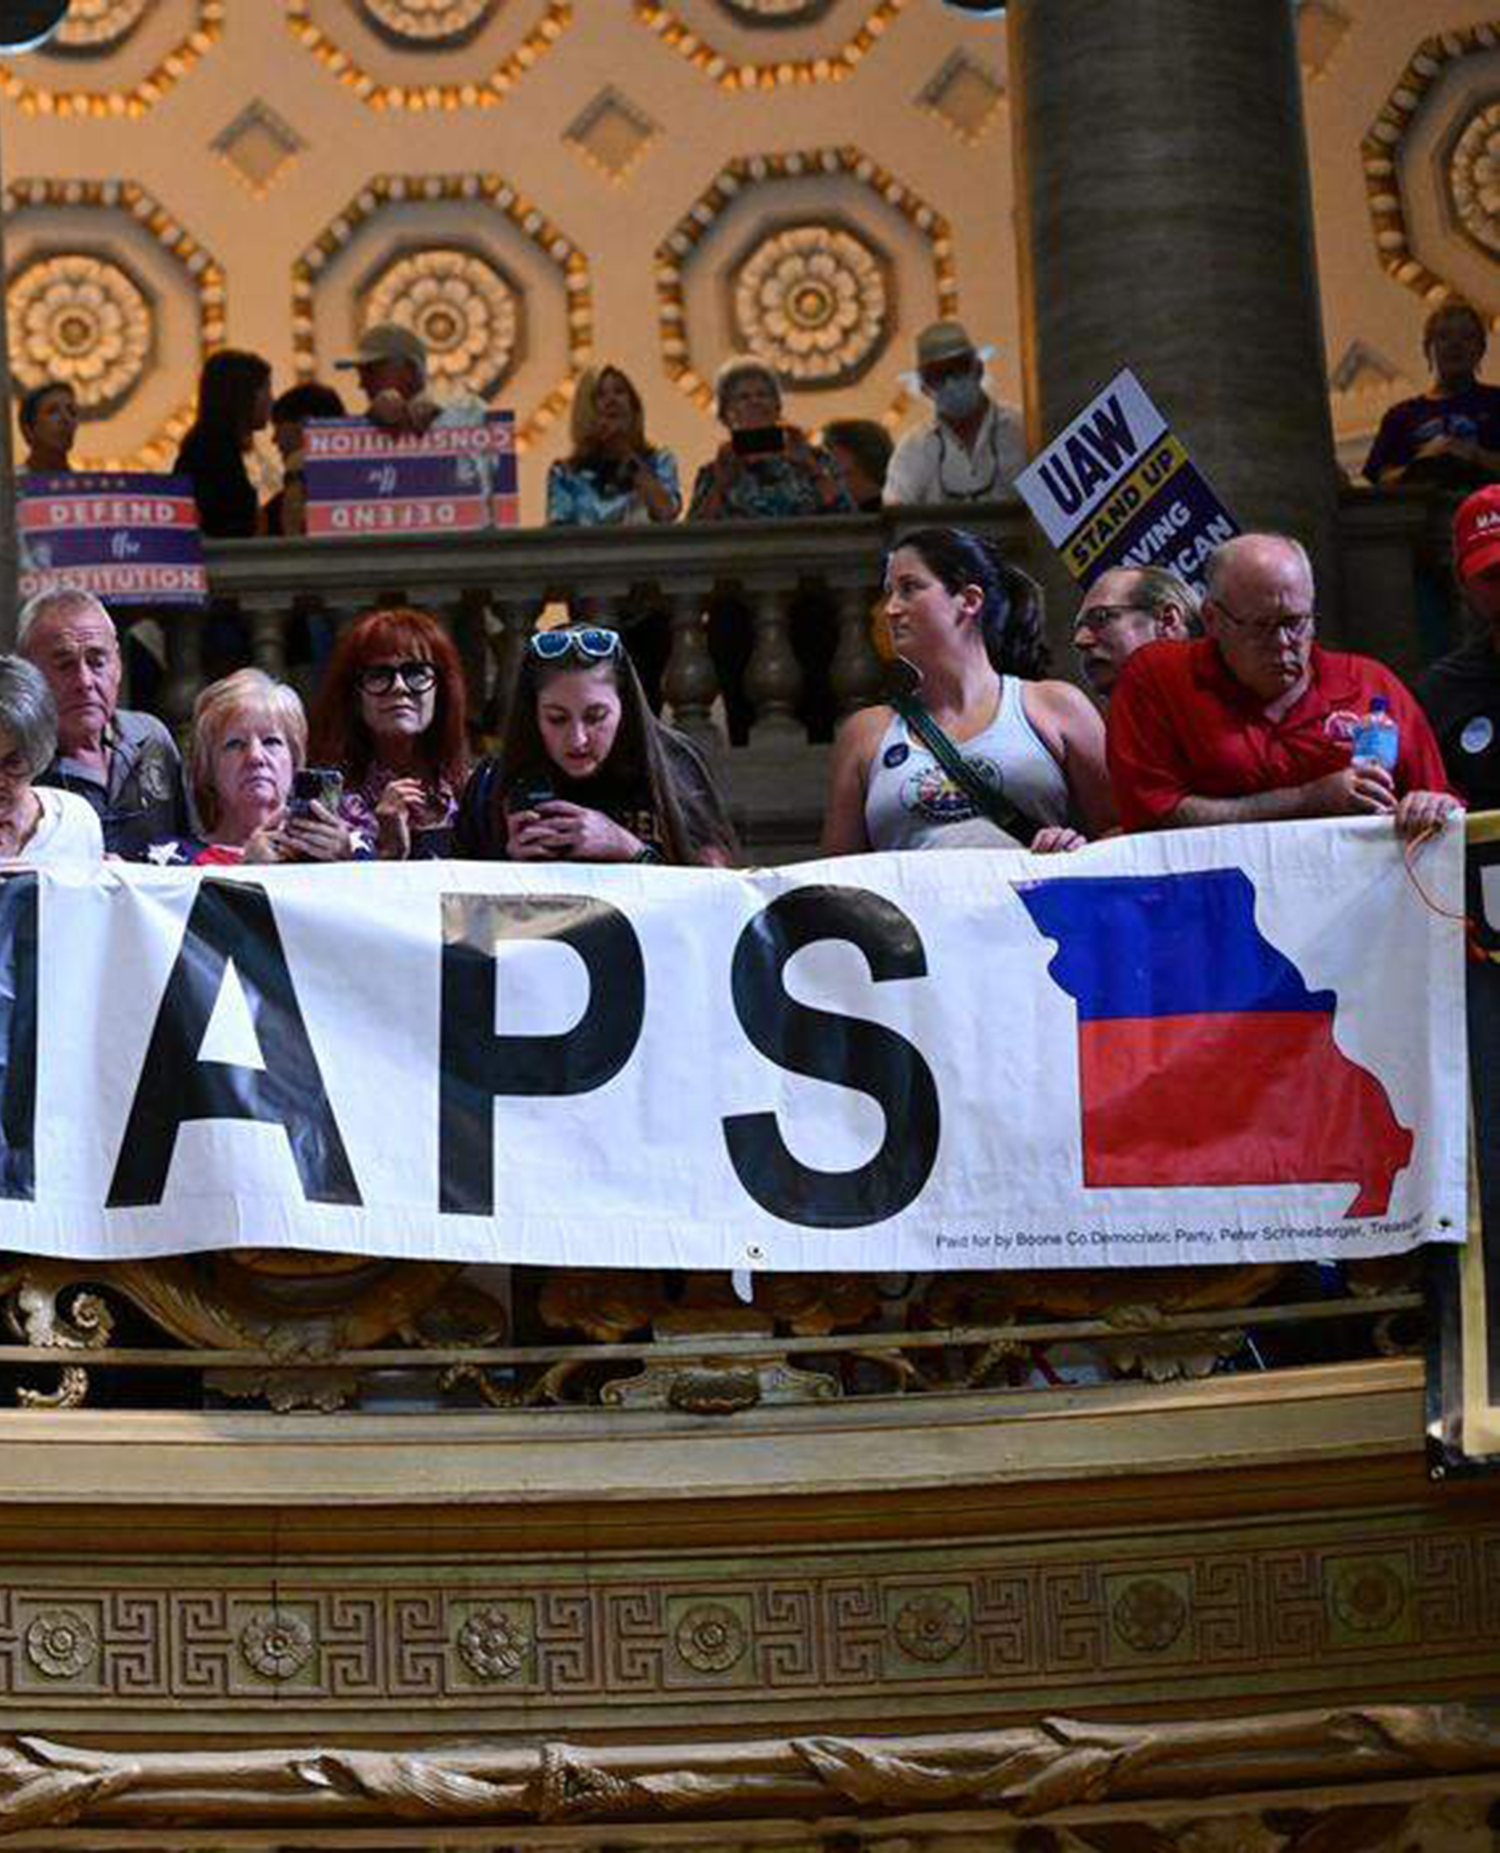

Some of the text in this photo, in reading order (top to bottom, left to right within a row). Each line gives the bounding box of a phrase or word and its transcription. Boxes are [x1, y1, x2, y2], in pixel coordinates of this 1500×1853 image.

[1038, 394, 1138, 516] UAW
[50, 502, 176, 524] DEFEND
[331, 504, 456, 528] DEFEND
[1071, 448, 1176, 567] STAND UP
[18, 567, 204, 595] ONSTITUTION
[936, 1234, 968, 1248] Paid
[972, 1233, 991, 1248] for
[994, 1233, 1014, 1250] by
[1016, 1231, 1062, 1246] Boone
[1090, 1230, 1171, 1245] Democratic
[1220, 1227, 1257, 1241] Peter
